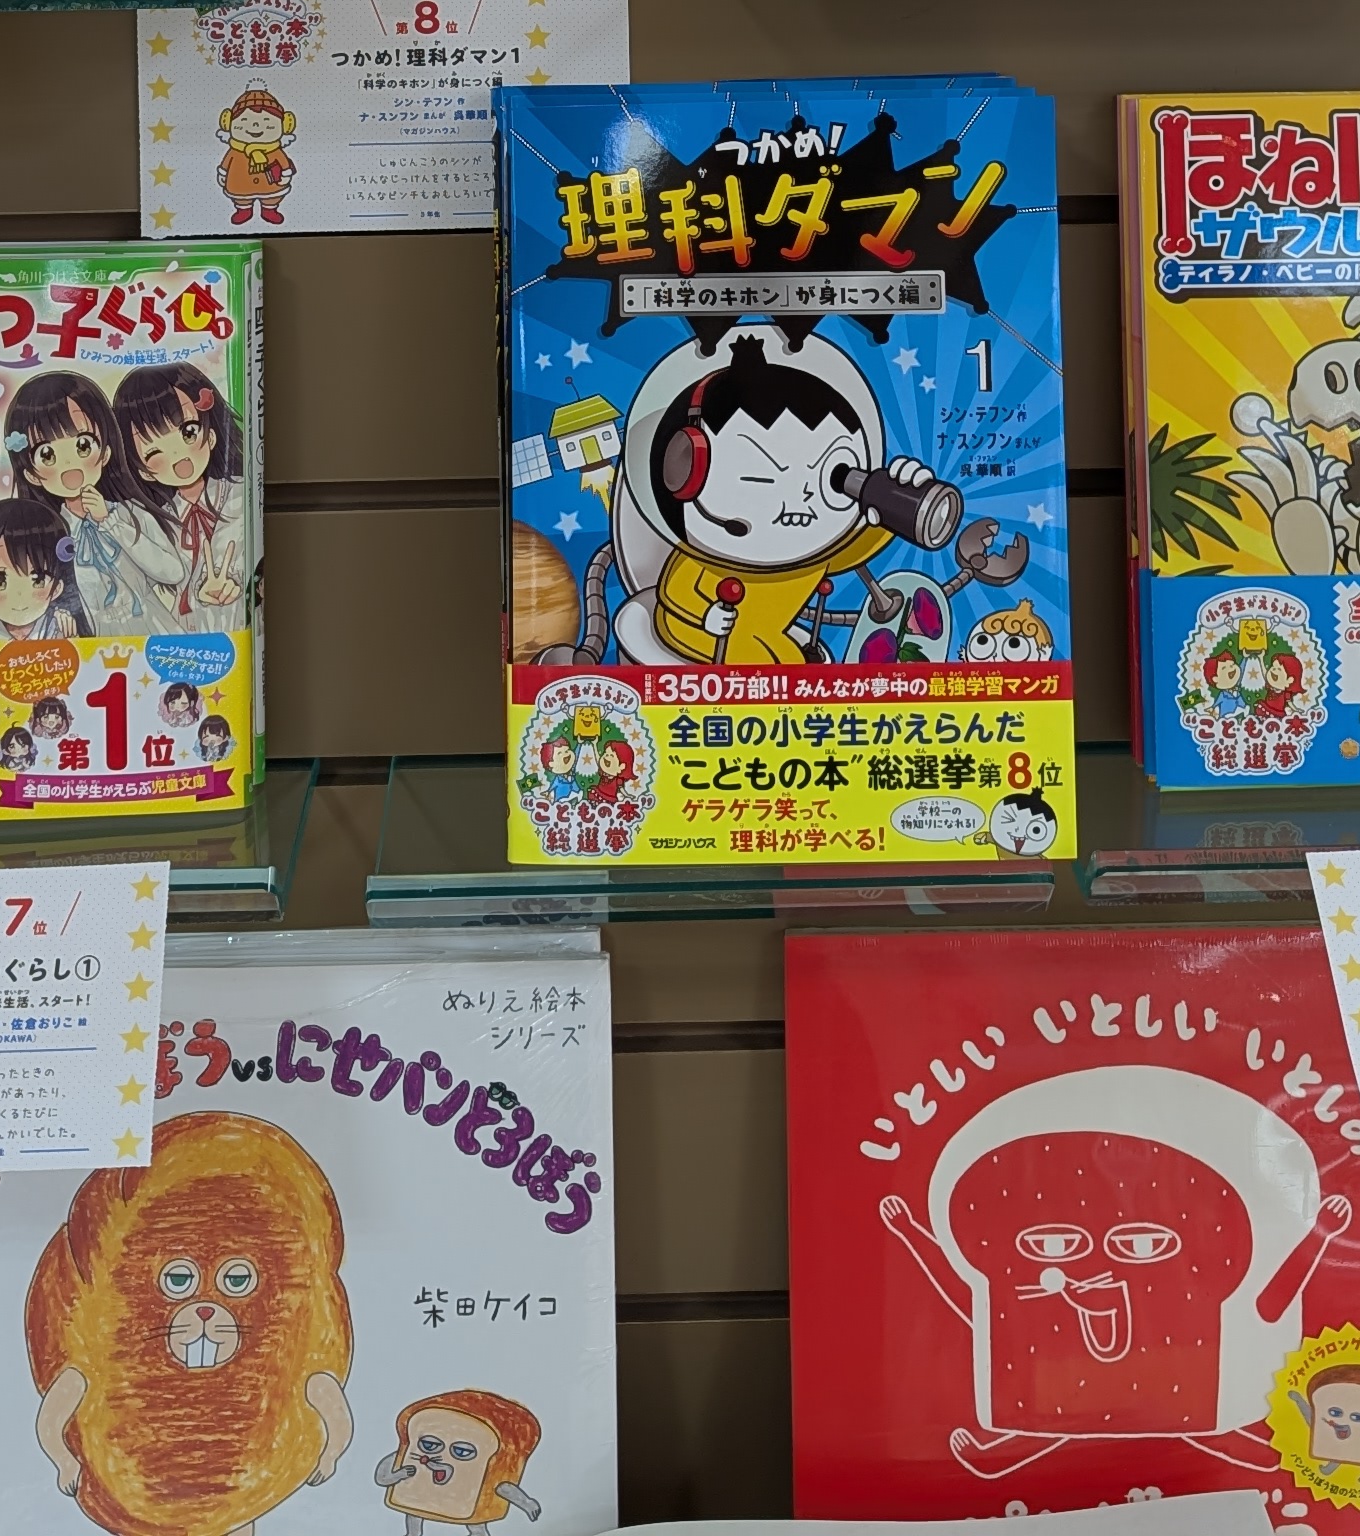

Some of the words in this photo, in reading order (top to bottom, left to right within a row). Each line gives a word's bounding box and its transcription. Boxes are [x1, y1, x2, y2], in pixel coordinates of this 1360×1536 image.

[396, 0, 460, 35] 第8位
[331, 47, 522, 67] つかめ!理科ダマン1
[359, 110, 419, 122] ナ・スンフン
[393, 96, 454, 107] シン・テフン
[714, 125, 843, 166] つかめ!
[557, 162, 1006, 275] 理科ダマン
[638, 285, 921, 308] 「科学のキホン」が身につく編
[964, 339, 992, 392] 1
[657, 672, 788, 702] 350万部!!
[794, 675, 1060, 697] みんなが夢中の最強学習マンガ
[58, 671, 175, 771] 第1位
[667, 711, 1026, 748] 全国の小学生がえらんだ
[681, 798, 839, 821] ゲラゲラ笑って、
[649, 837, 717, 849] マガジンハウス
[729, 827, 887, 853] 理科が学べる!
[442, 986, 587, 1014] ぬりえ絵本
[490, 1023, 587, 1050] シリーズ
[859, 1026, 1006, 1161] いとしい
[1033, 994, 1218, 1042] いとしい
[413, 1286, 558, 1328] 柴田ケイコ
